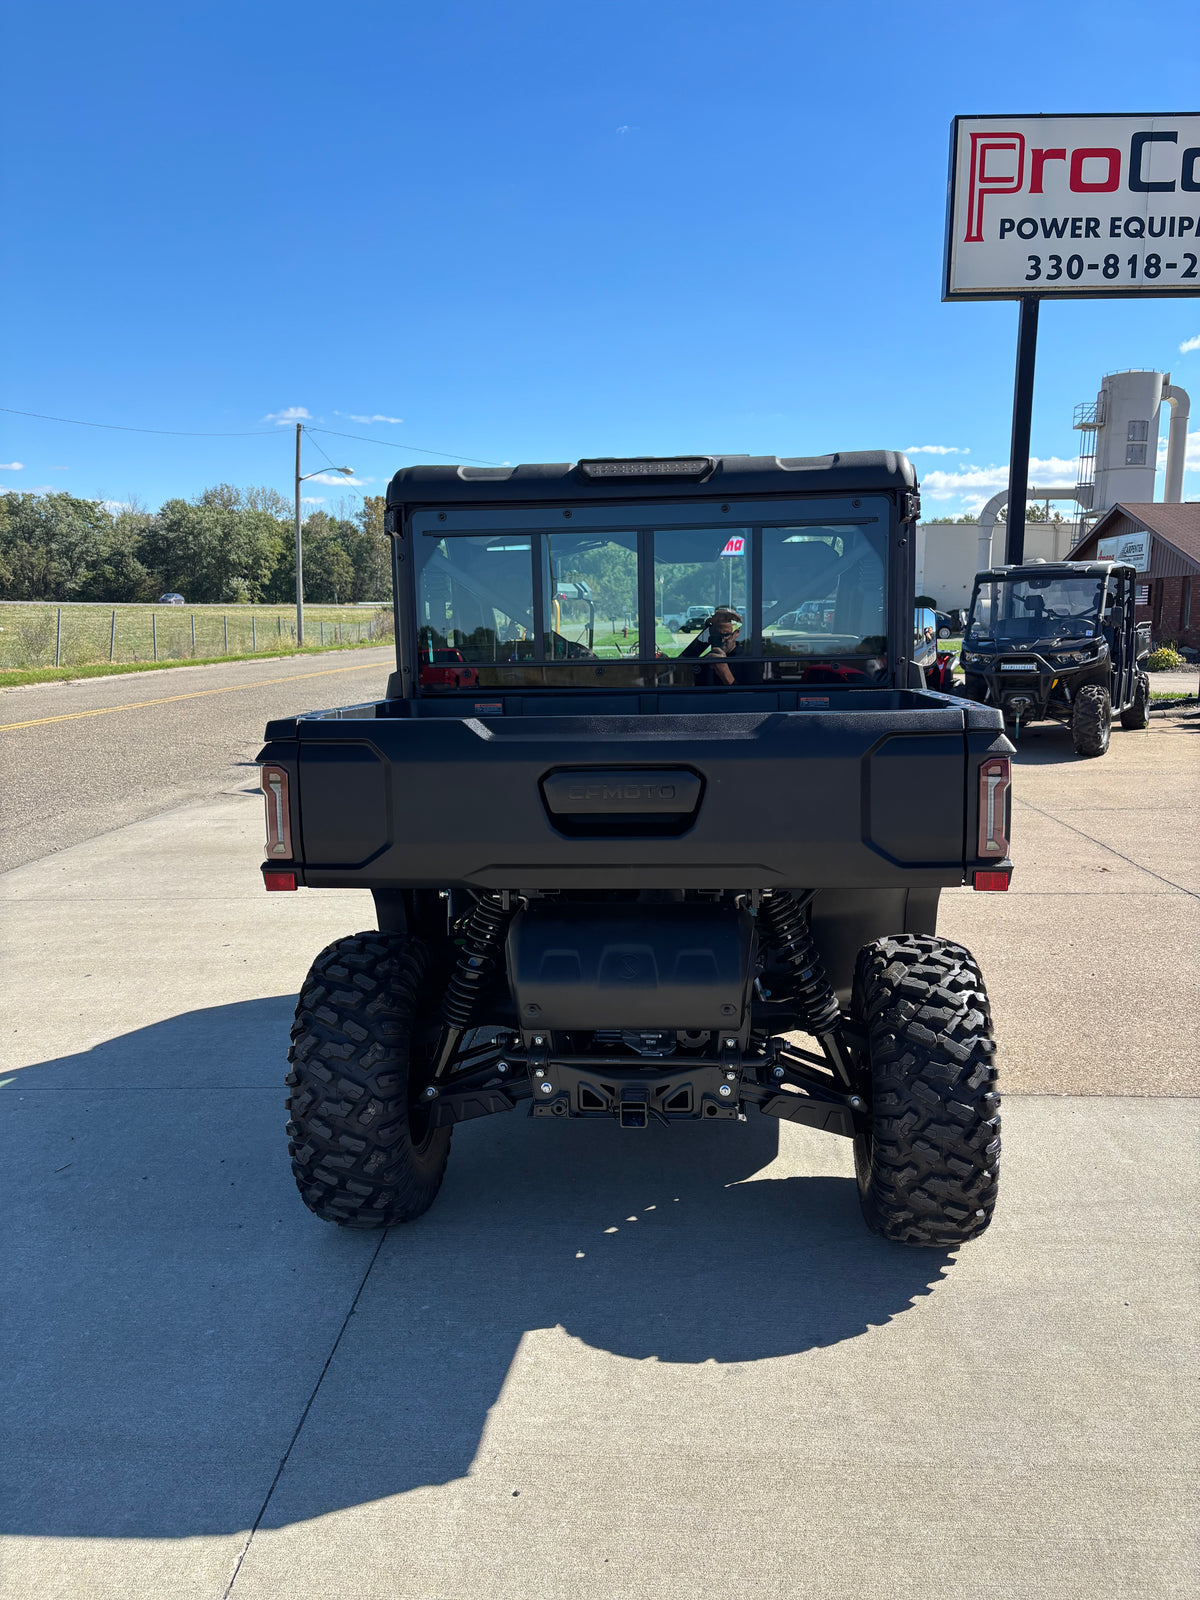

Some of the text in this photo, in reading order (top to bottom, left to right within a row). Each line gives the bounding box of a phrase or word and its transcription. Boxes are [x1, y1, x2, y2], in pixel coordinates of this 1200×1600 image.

[999, 215, 1200, 240] POWER EQUIP
[1025, 252, 1198, 281] 330-818-2
[567, 784, 677, 800] CFMOTO
